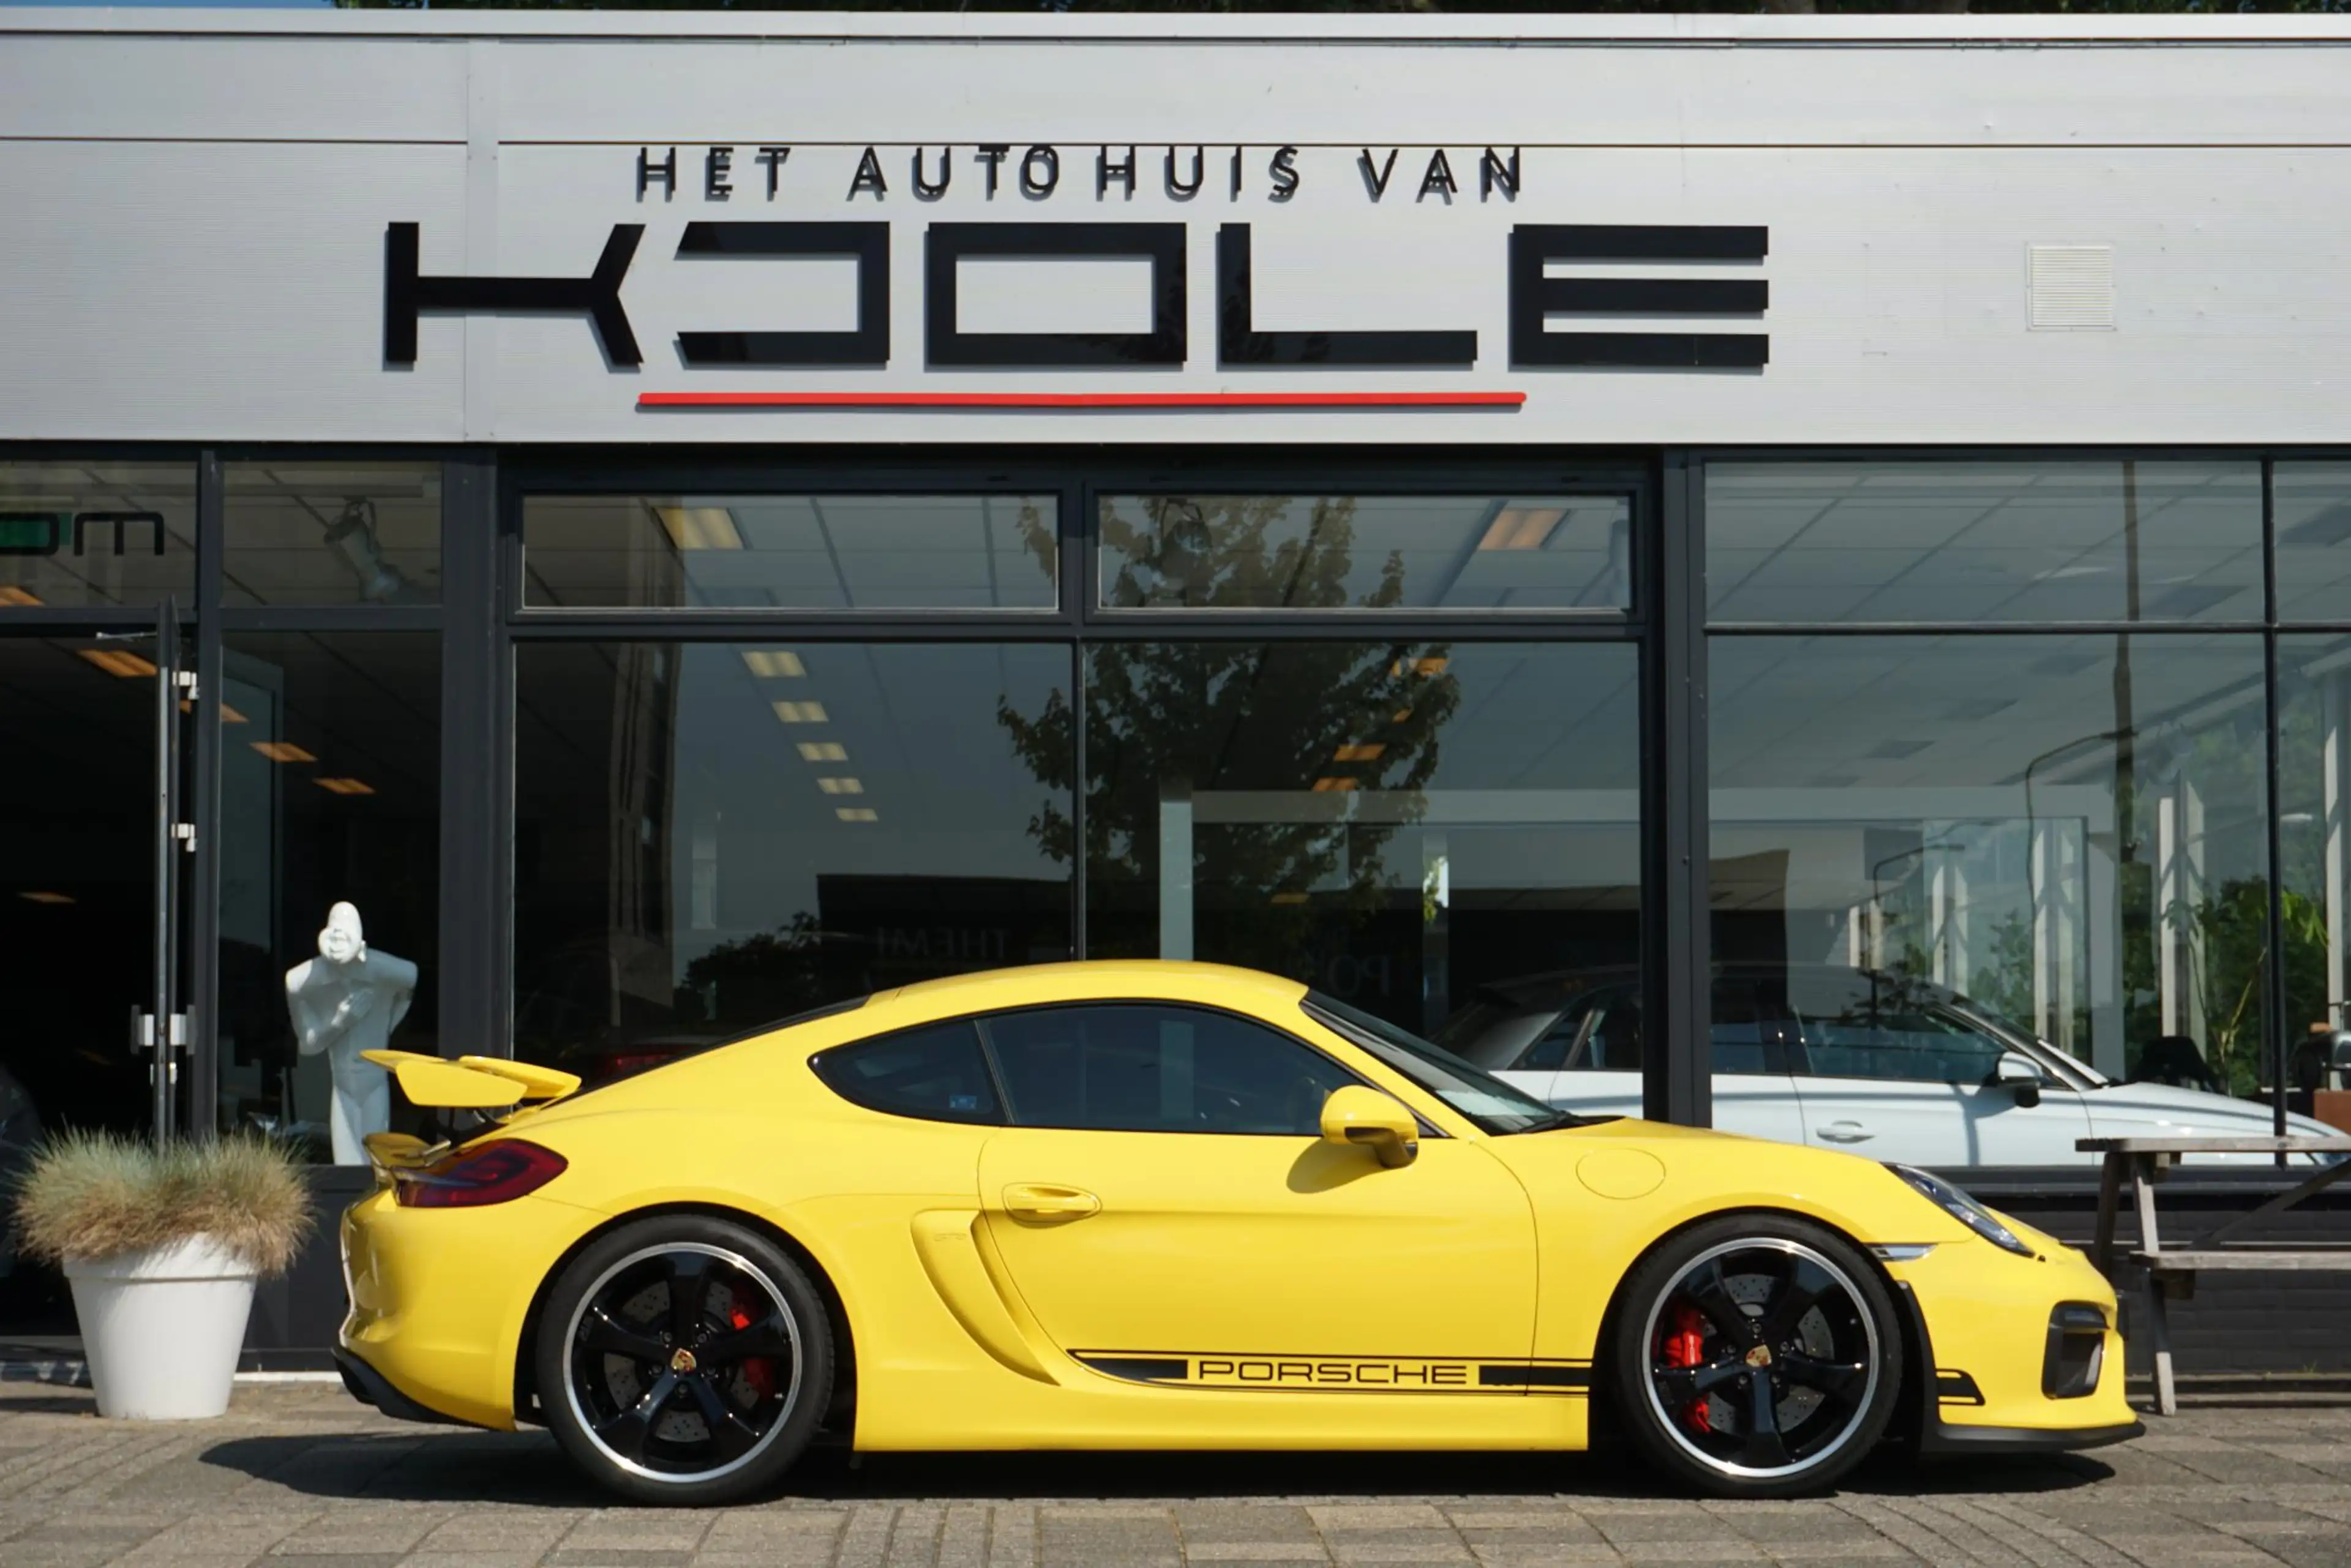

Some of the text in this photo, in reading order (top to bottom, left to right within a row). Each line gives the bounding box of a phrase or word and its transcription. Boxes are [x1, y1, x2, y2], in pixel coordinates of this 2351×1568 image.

[638, 144, 1520, 202] HET AUTOHUIS VAN
[384, 222, 1769, 371] KOOLE
[1199, 1360, 1467, 1385] PORSCHE
